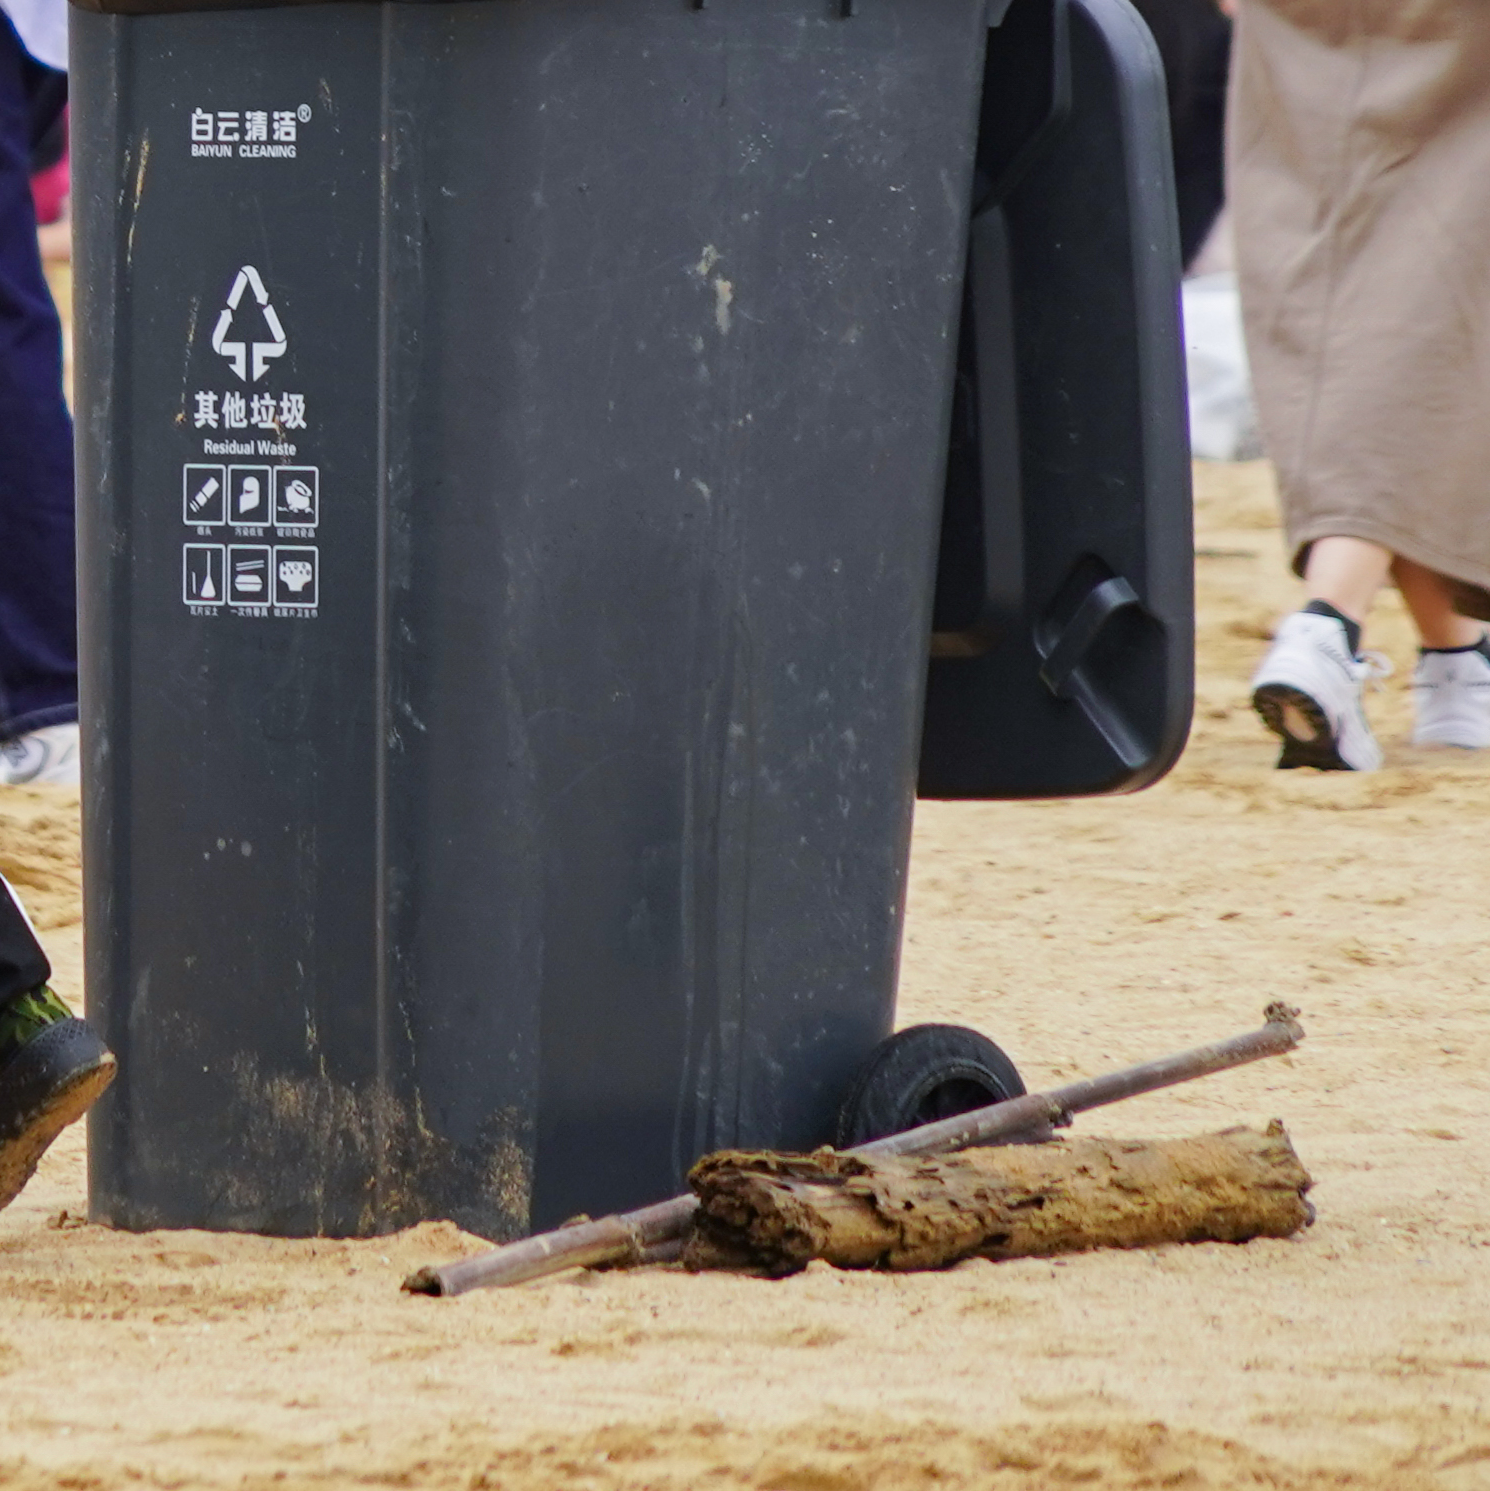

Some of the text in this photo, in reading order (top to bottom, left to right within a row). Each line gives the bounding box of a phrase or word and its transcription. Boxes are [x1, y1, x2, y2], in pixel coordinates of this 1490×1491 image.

[191, 107, 297, 142] 白云清洁
[191, 144, 296, 158] BAIYUN CLEANING
[194, 391, 307, 429] 其他垃圾
[204, 439, 297, 456] Residual Waste
